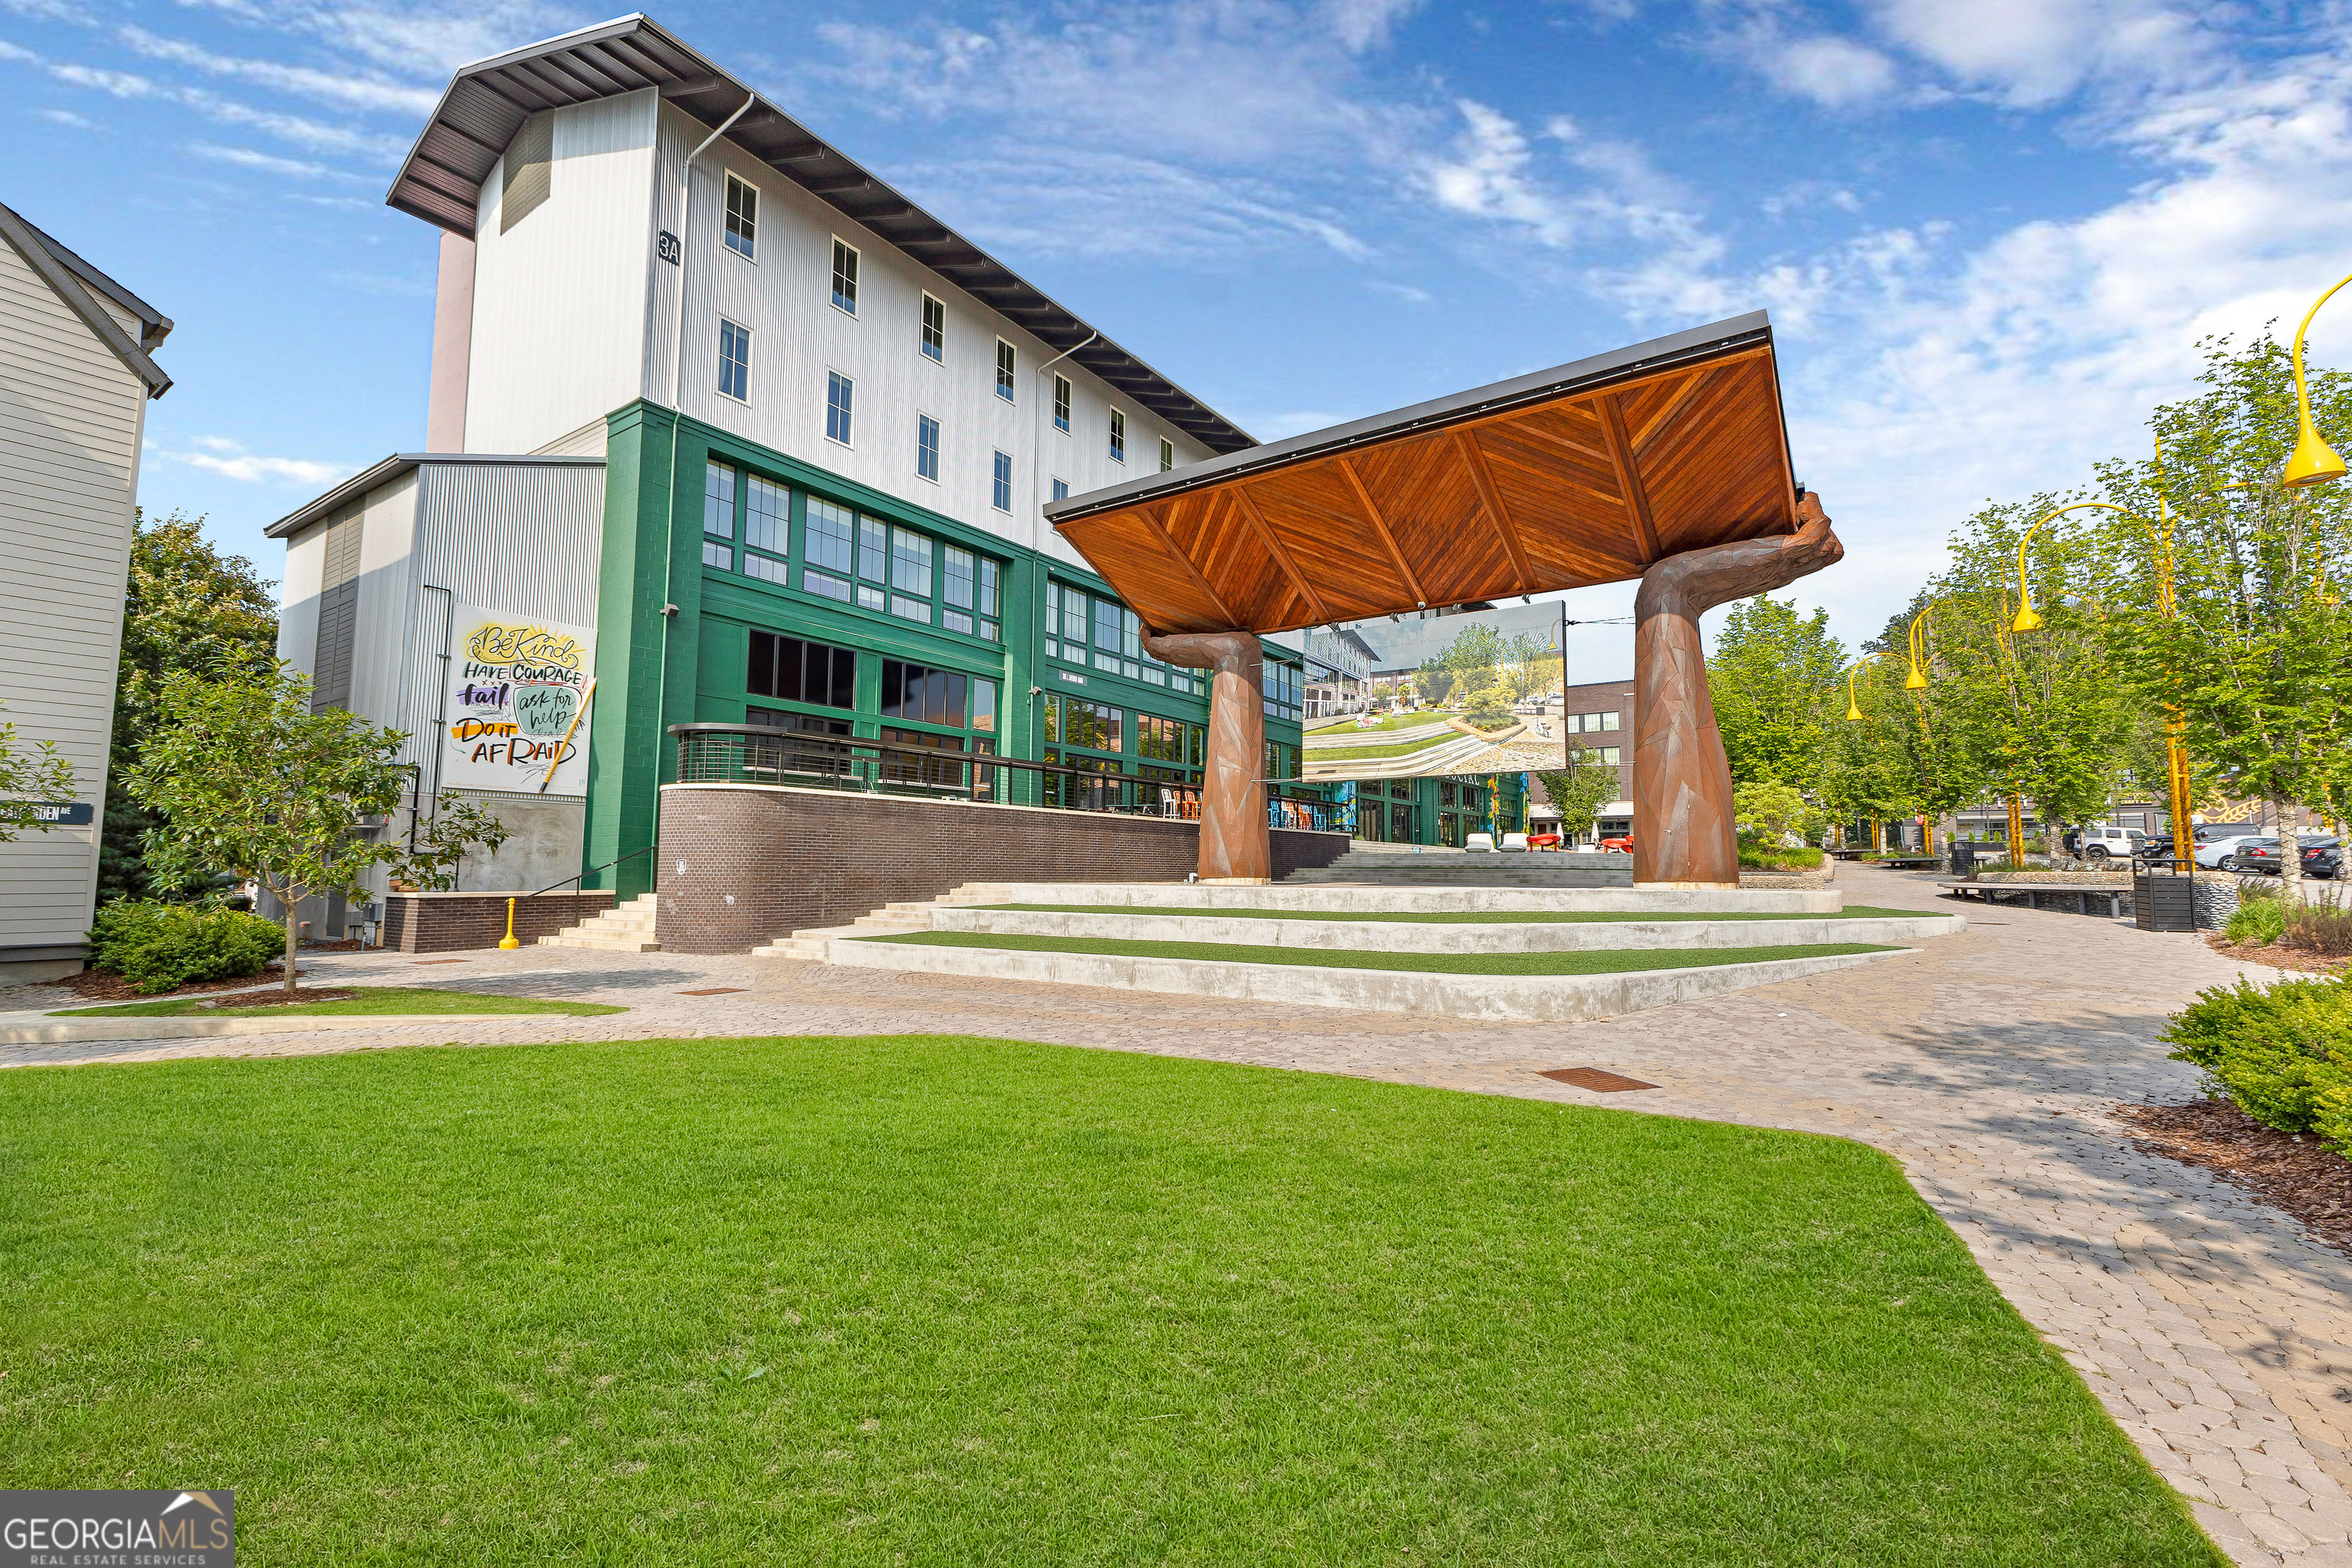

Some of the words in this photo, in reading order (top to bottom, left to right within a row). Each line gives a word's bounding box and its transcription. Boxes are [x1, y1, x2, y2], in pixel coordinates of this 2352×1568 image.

[659, 235, 679, 263] 3A
[469, 626, 514, 657] Be
[501, 628, 579, 668] Kind
[464, 662, 508, 679] HAVE
[514, 664, 583, 684] COURAGE
[456, 683, 510, 710] fail
[520, 691, 550, 710] ask
[553, 688, 574, 710] for
[456, 717, 495, 742] Do
[531, 707, 577, 729] help
[1446, 774, 1480, 786] CIAL
